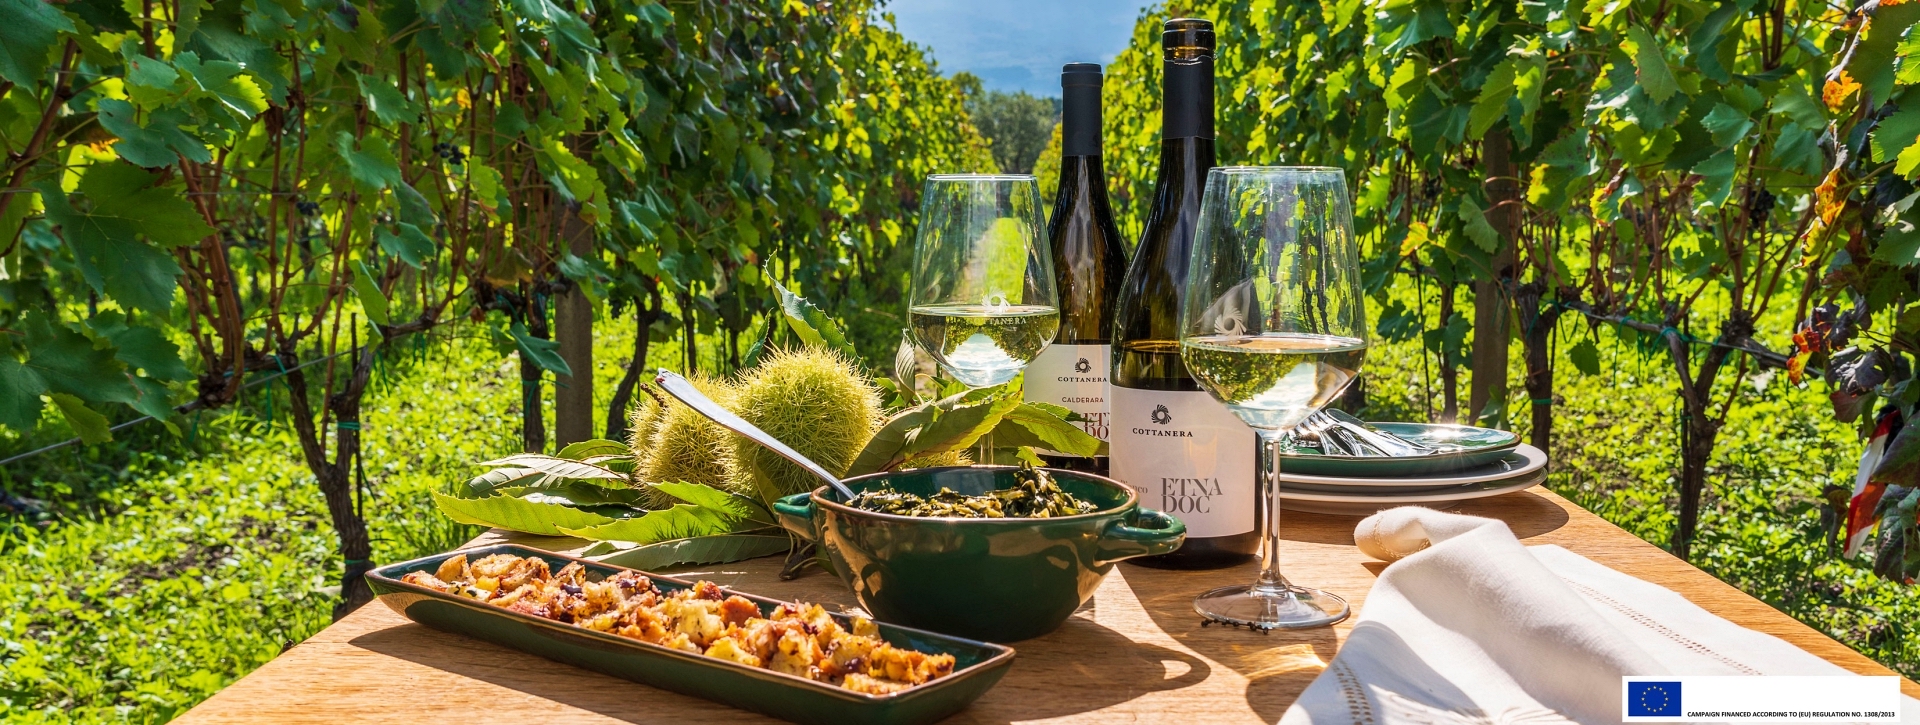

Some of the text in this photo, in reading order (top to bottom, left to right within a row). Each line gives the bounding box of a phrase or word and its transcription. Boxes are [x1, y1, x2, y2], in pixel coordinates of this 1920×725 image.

[1083, 412, 1109, 427] ET
[1132, 427, 1194, 438] COTTANERA
[1161, 478, 1223, 496] ETNA
[1161, 494, 1211, 514] DOC
